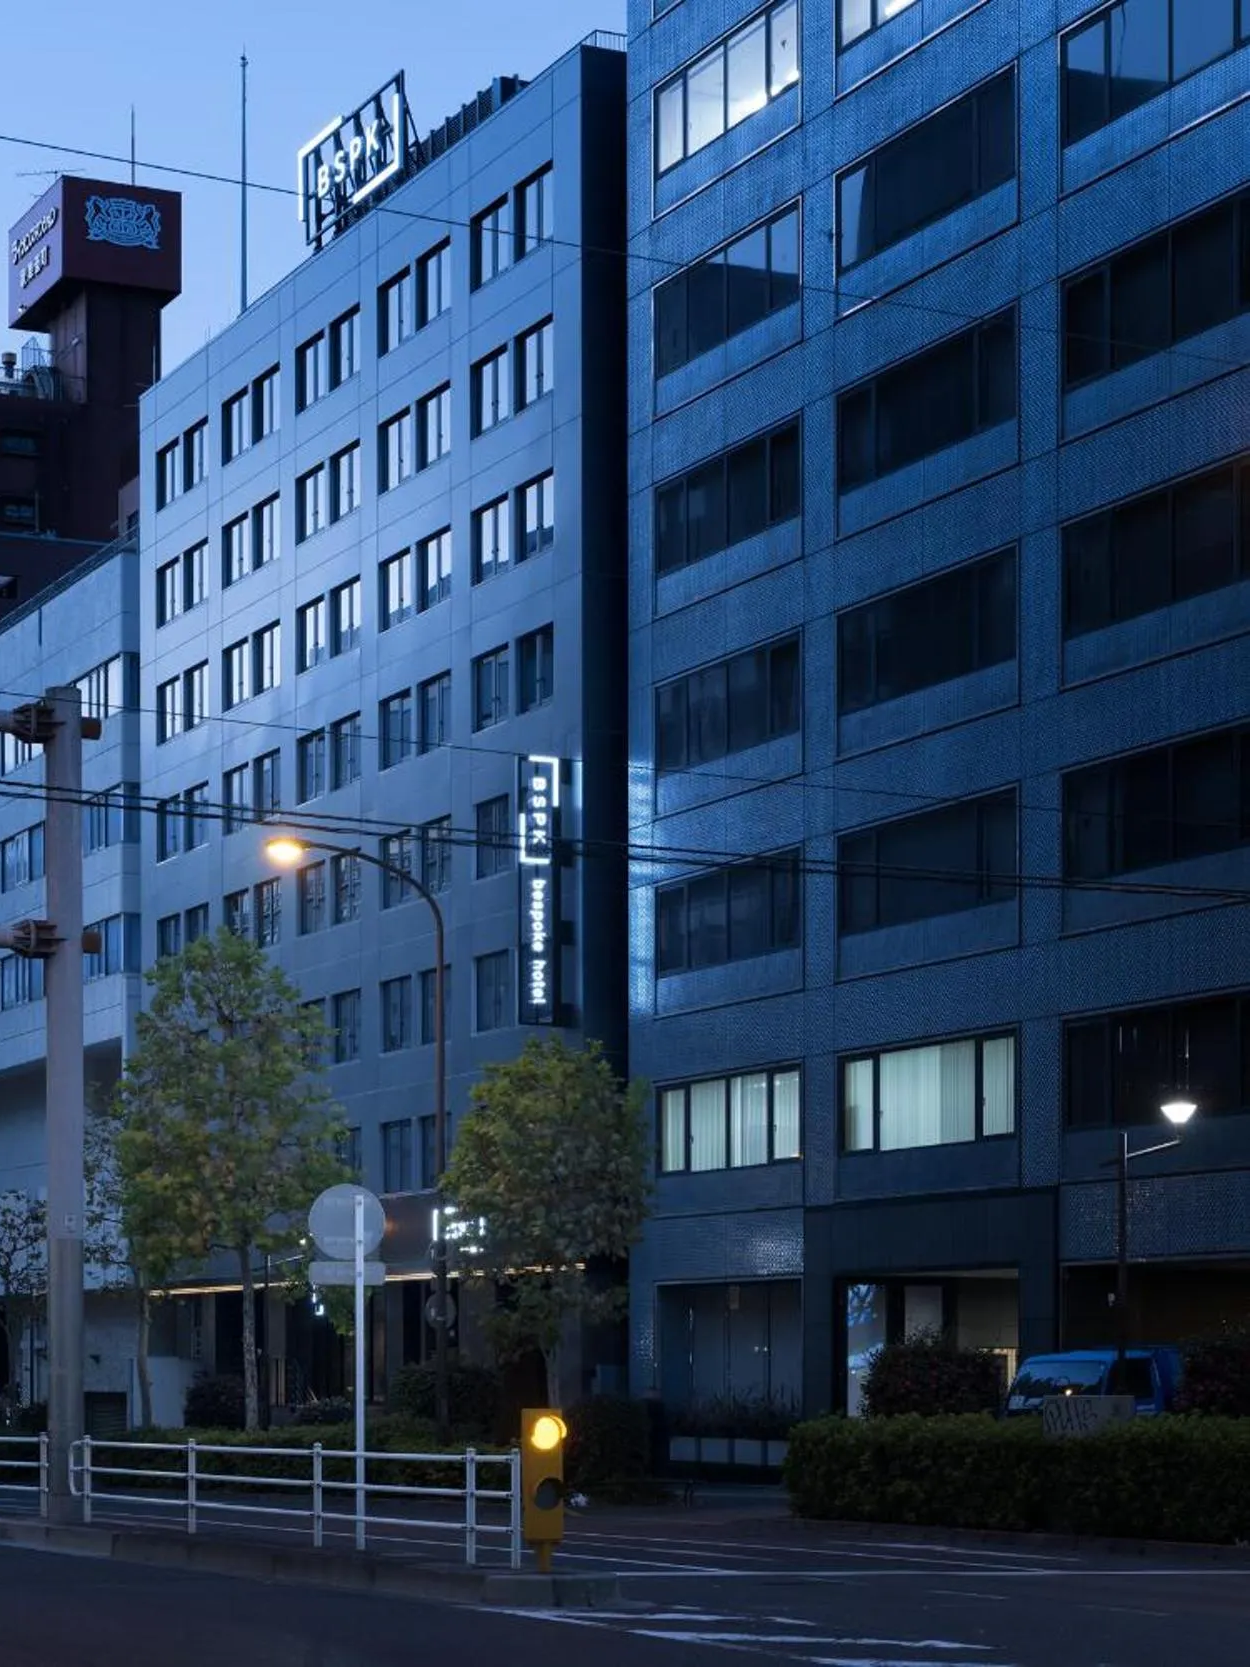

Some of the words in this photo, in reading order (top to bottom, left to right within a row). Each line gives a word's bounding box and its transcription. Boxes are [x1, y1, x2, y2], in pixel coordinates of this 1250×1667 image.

[317, 119, 379, 198] BSPK
[532, 777, 548, 844] BSPK
[530, 879, 548, 953] bespoke
[531, 960, 547, 1004] hotel
